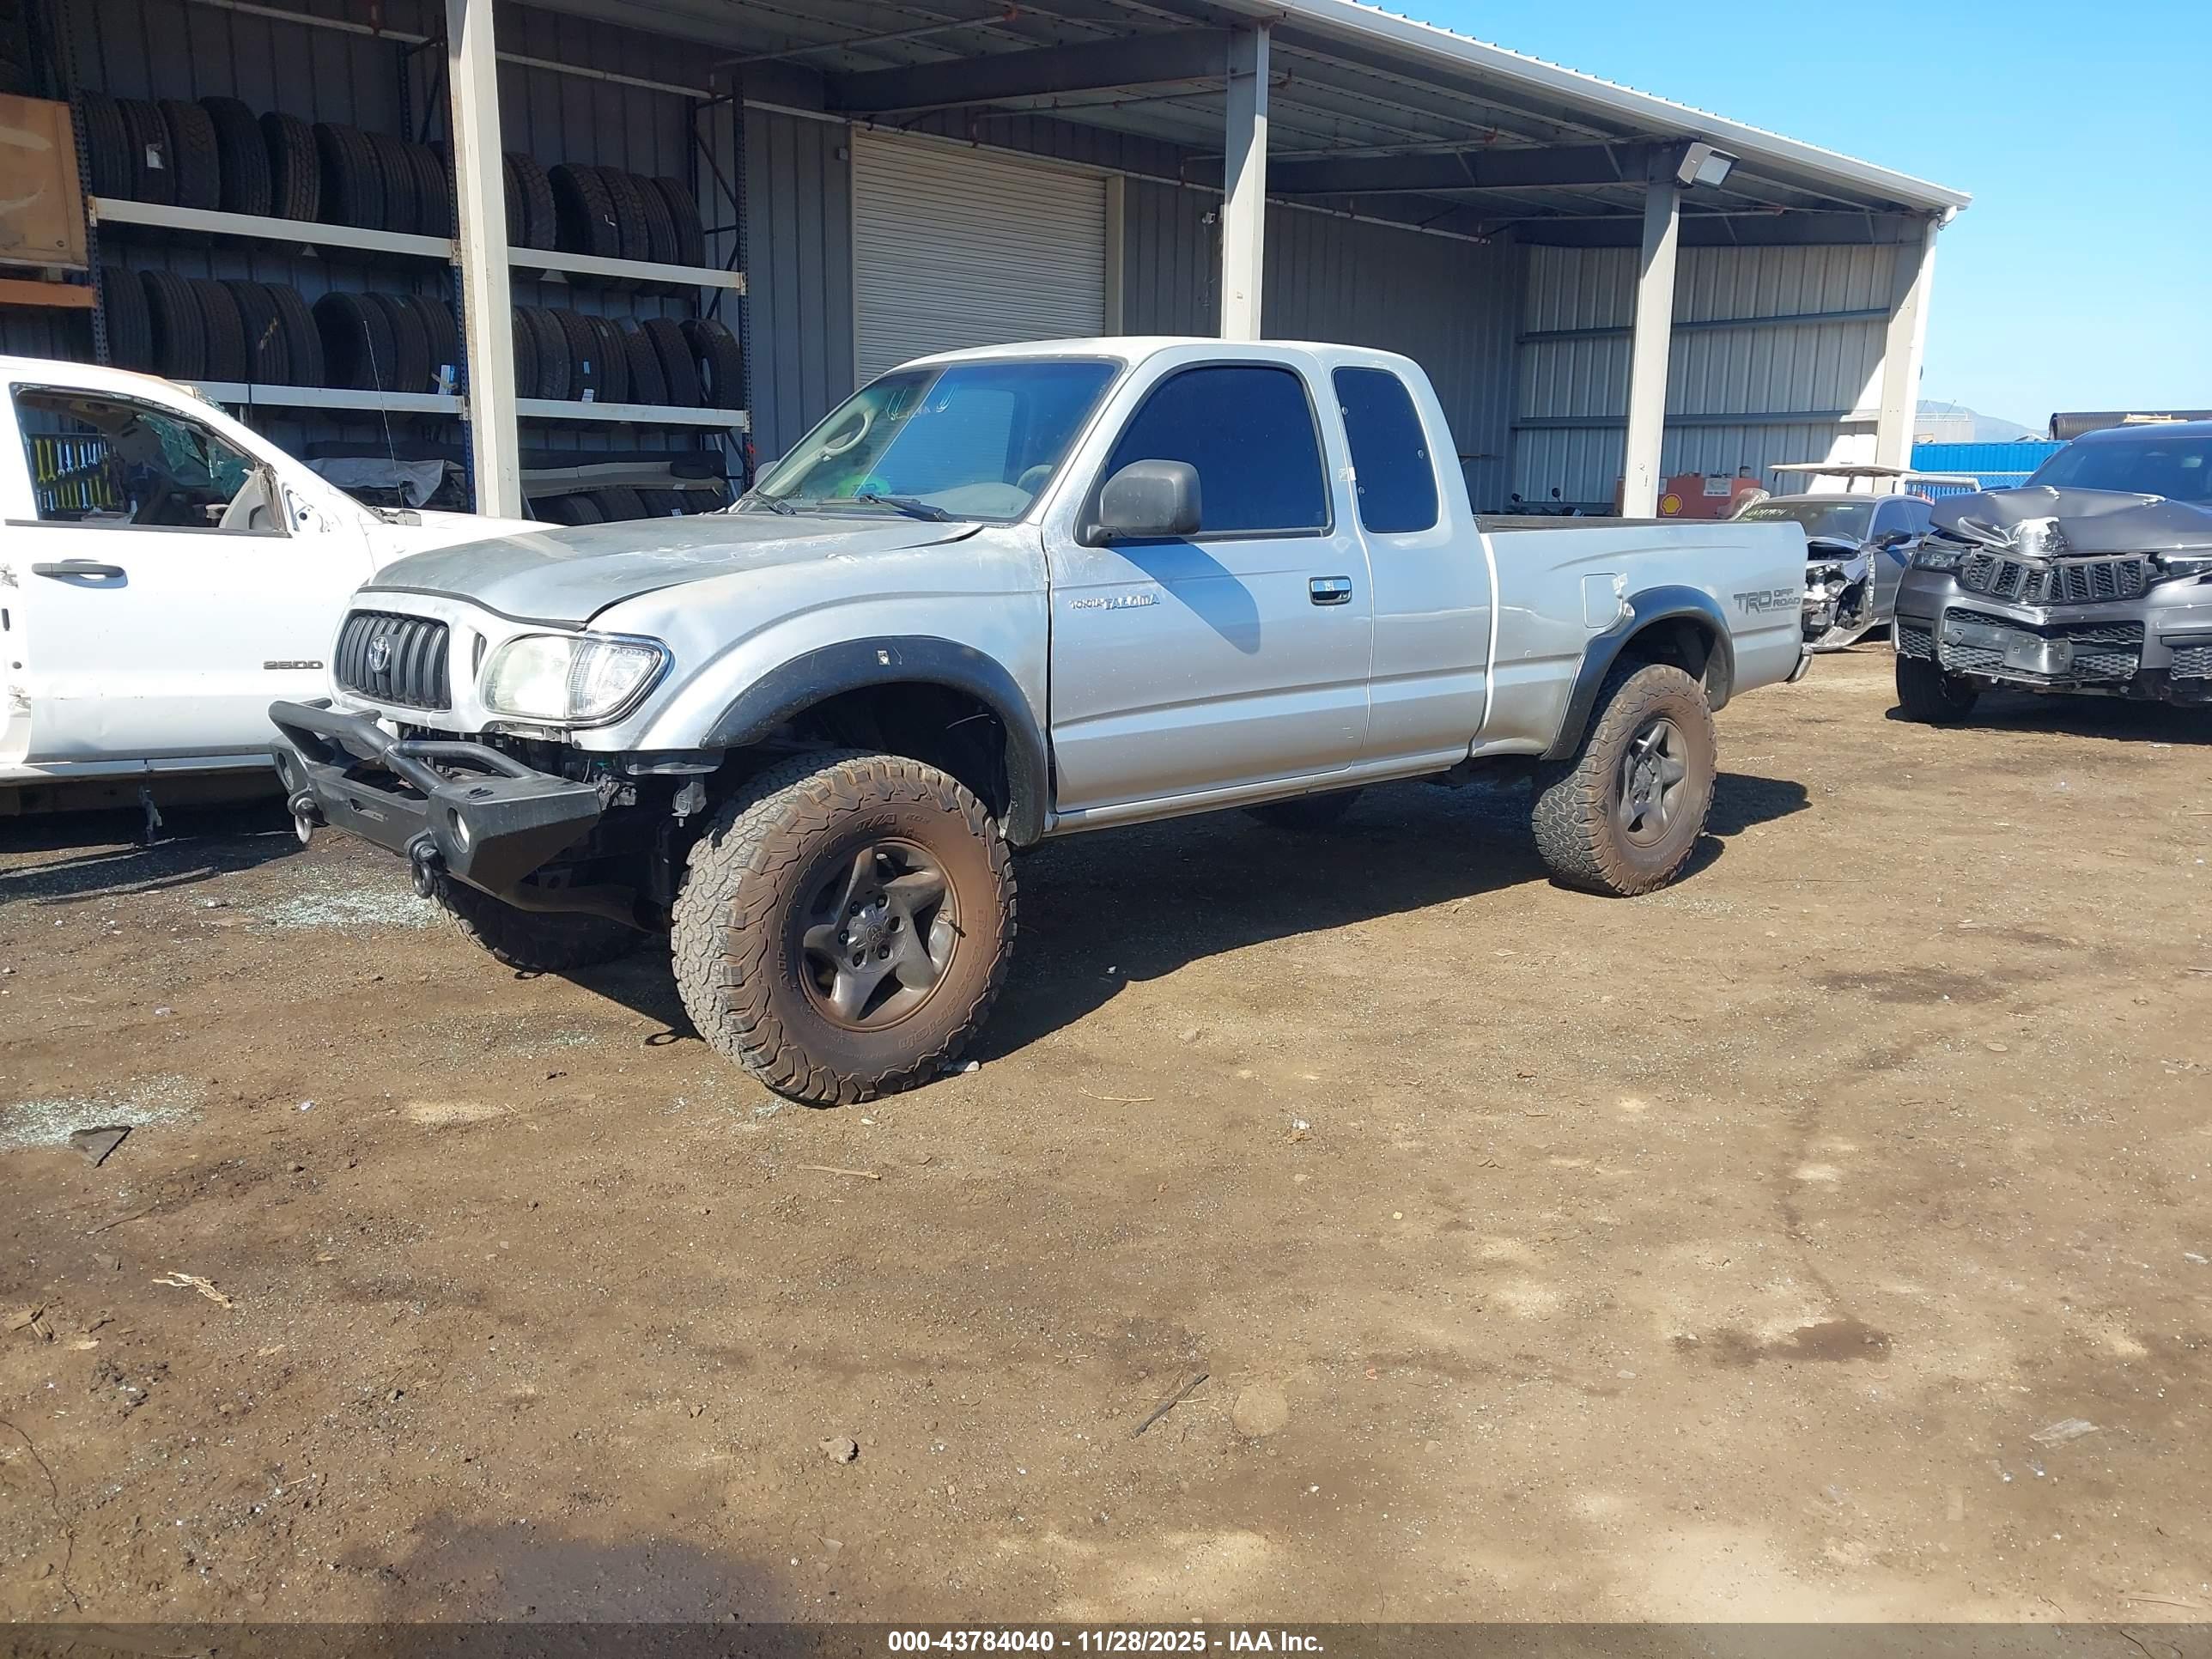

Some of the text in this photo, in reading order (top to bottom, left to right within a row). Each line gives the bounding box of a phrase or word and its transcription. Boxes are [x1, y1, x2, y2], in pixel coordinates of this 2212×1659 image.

[1104, 593, 1161, 611] TACOMA
[1733, 587, 1794, 616] TRD OFF
[1772, 597, 1801, 607] ROAD
[263, 659, 324, 670] 2500
